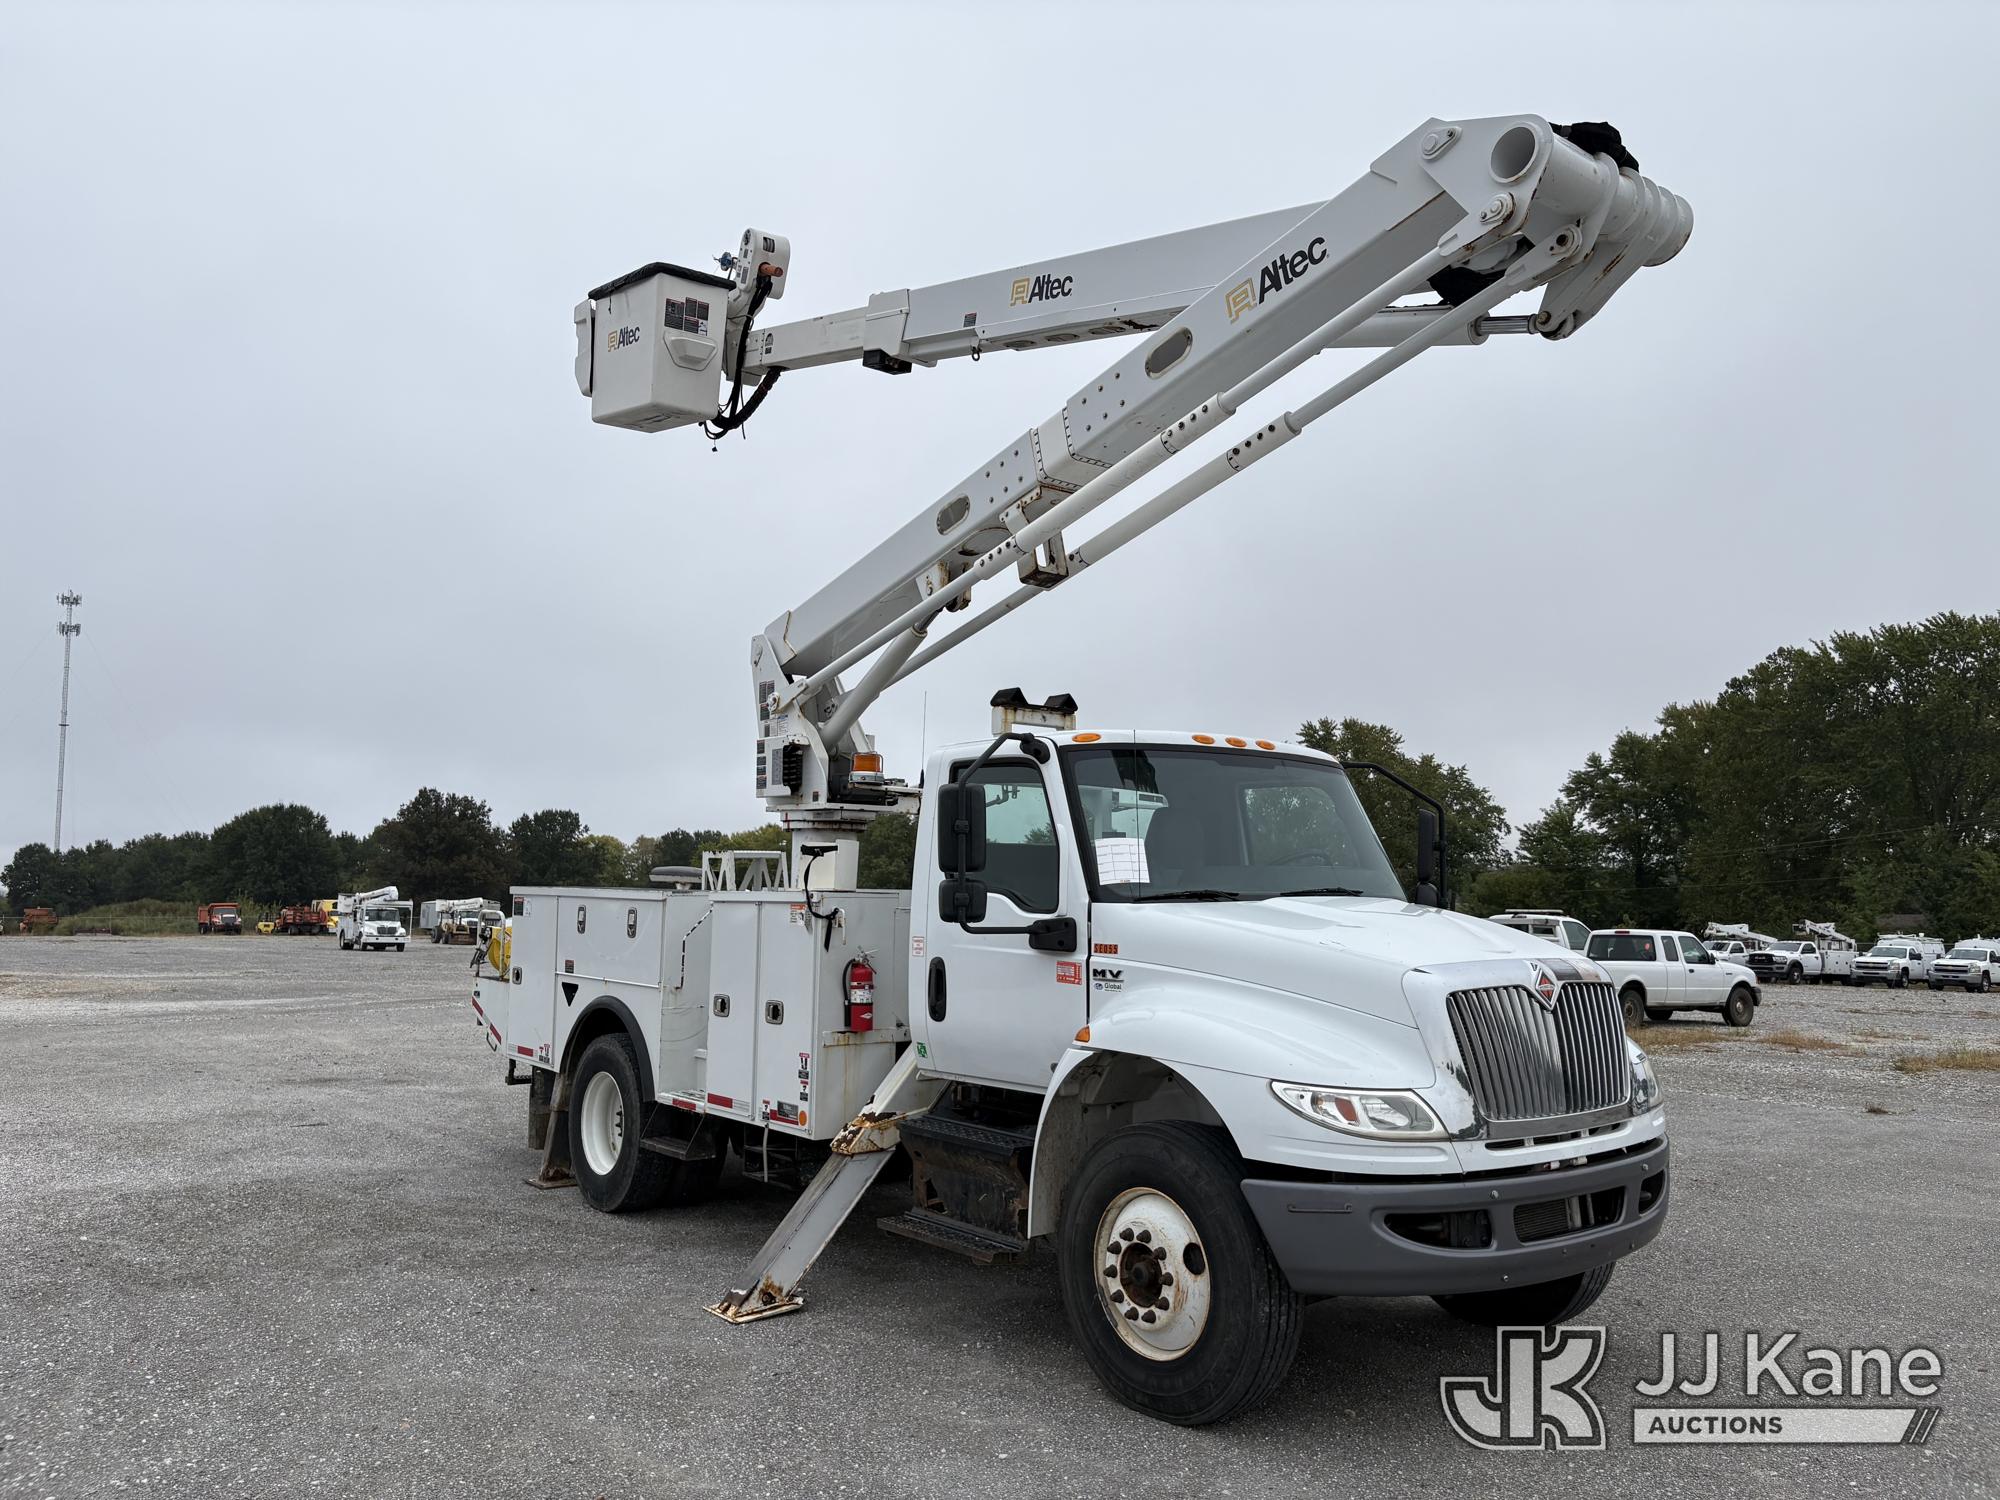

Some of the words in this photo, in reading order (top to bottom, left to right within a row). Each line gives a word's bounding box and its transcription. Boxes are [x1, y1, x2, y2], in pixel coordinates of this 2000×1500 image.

[1258, 236, 1328, 304] Altec
[1027, 273, 1074, 304] Altec
[617, 325, 641, 350] Altec
[1092, 968, 1122, 979] MV
[1104, 982, 1121, 990] Global
